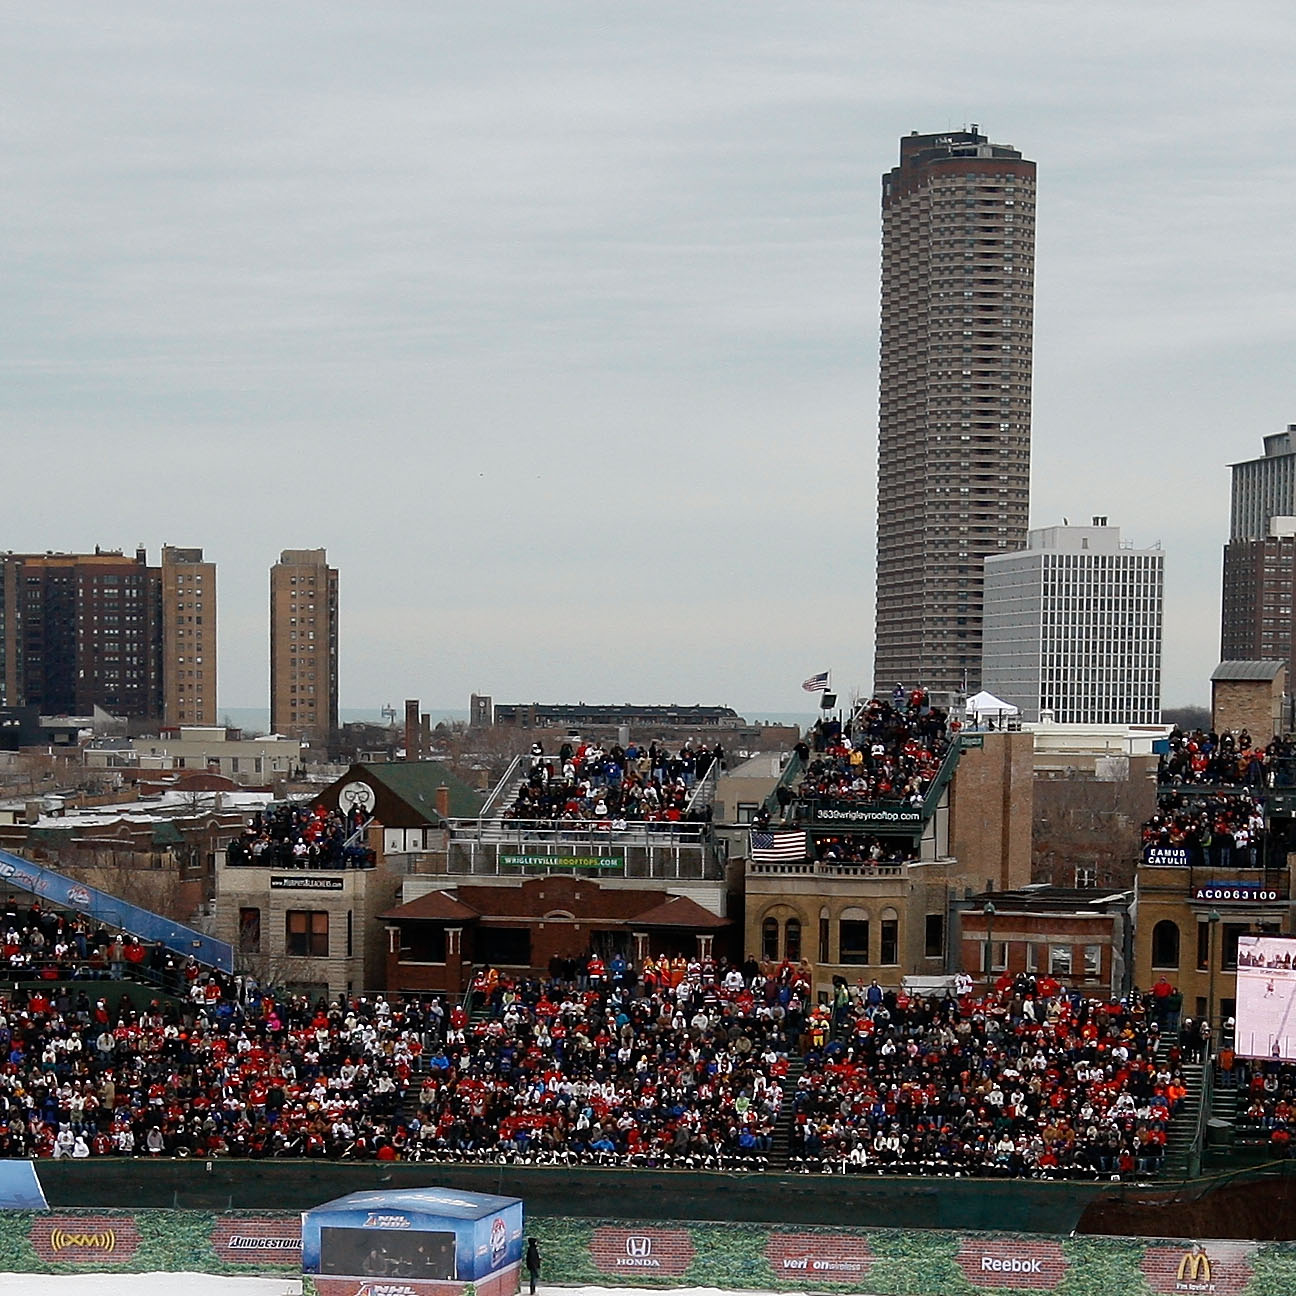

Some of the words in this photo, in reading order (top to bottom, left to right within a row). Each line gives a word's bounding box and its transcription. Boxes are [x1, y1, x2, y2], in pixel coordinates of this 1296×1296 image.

[816, 810, 920, 822] 3639wrigleyrooftop.com
[378, 1214, 408, 1222] NHL
[228, 1235, 303, 1250] BRIDGESTONE
[616, 1256, 660, 1268] HONDA
[981, 1256, 1042, 1273] Reebok
[374, 1284, 416, 1294] NHL
